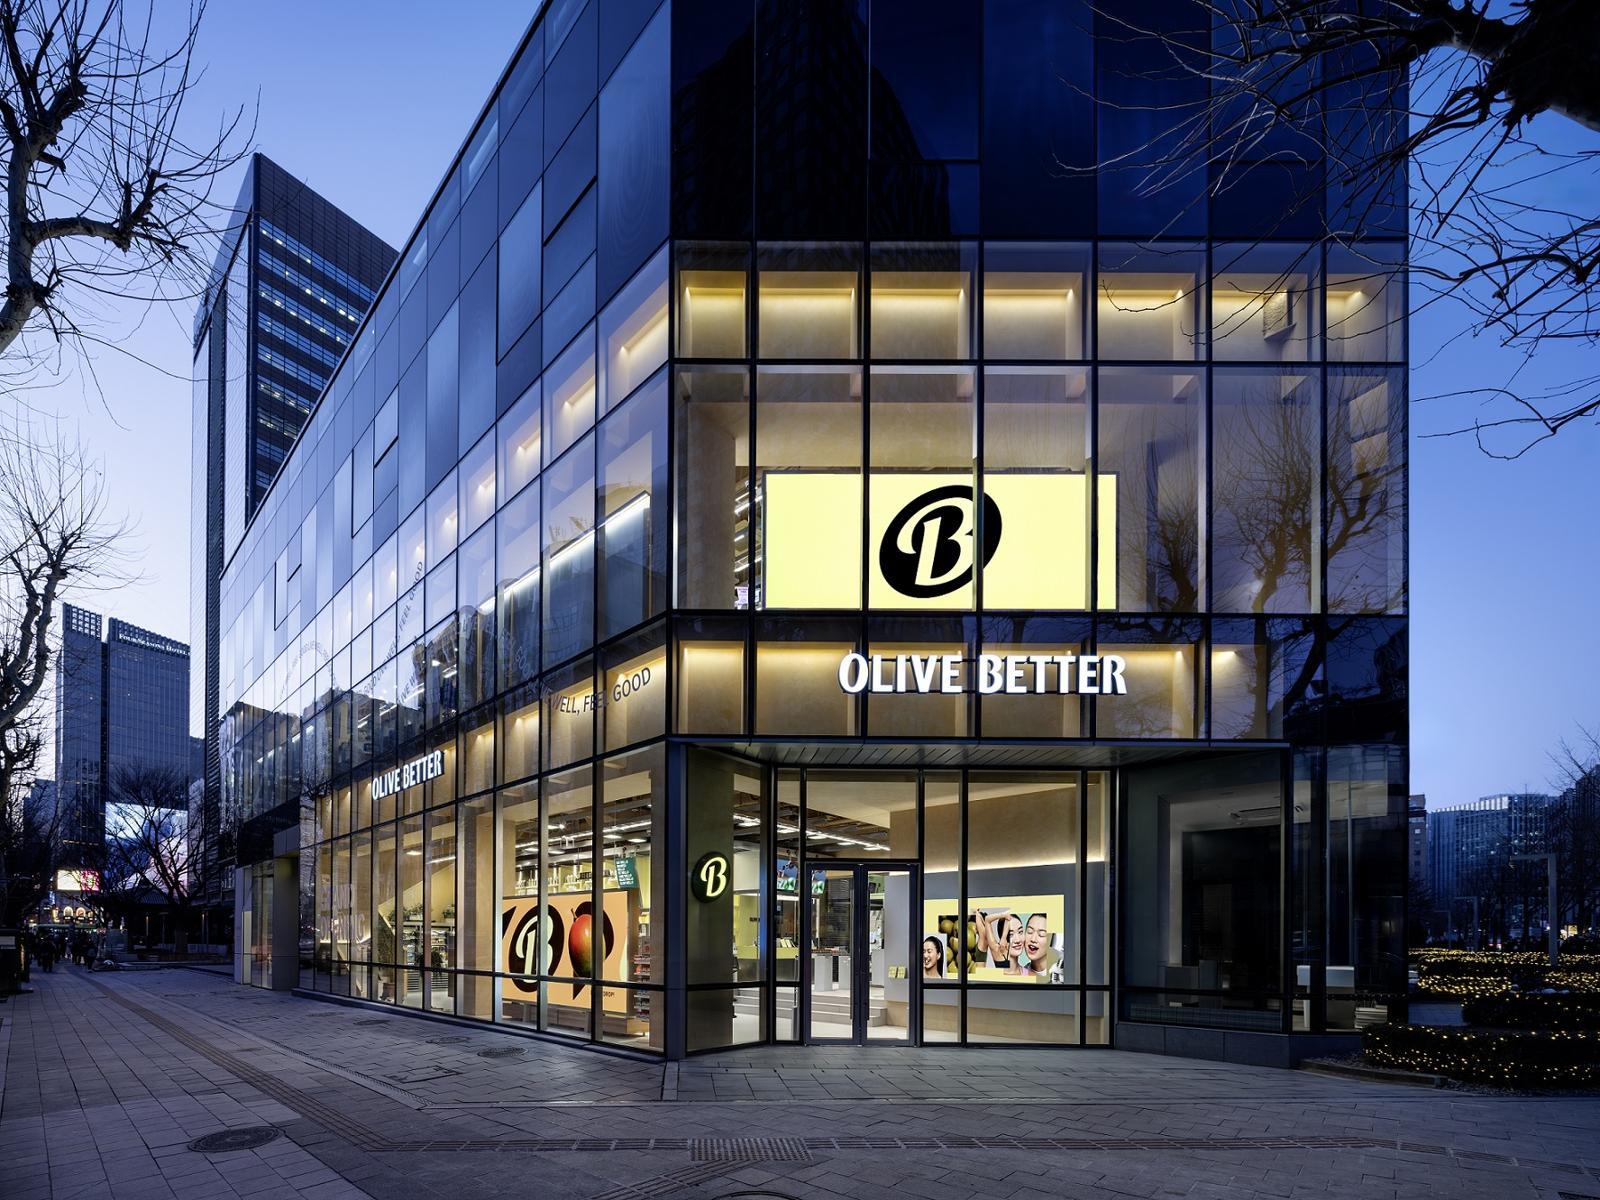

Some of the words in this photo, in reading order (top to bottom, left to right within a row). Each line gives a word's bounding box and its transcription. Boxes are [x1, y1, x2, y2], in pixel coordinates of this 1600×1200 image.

[896, 497, 980, 586] B
[551, 693, 580, 716] WELL,
[613, 667, 651, 702] GOOD
[838, 652, 963, 694] OLIVE
[977, 653, 1128, 695] BETTER
[372, 768, 401, 801] OLIVE
[403, 750, 443, 789] BETTER
[700, 857, 727, 897] B
